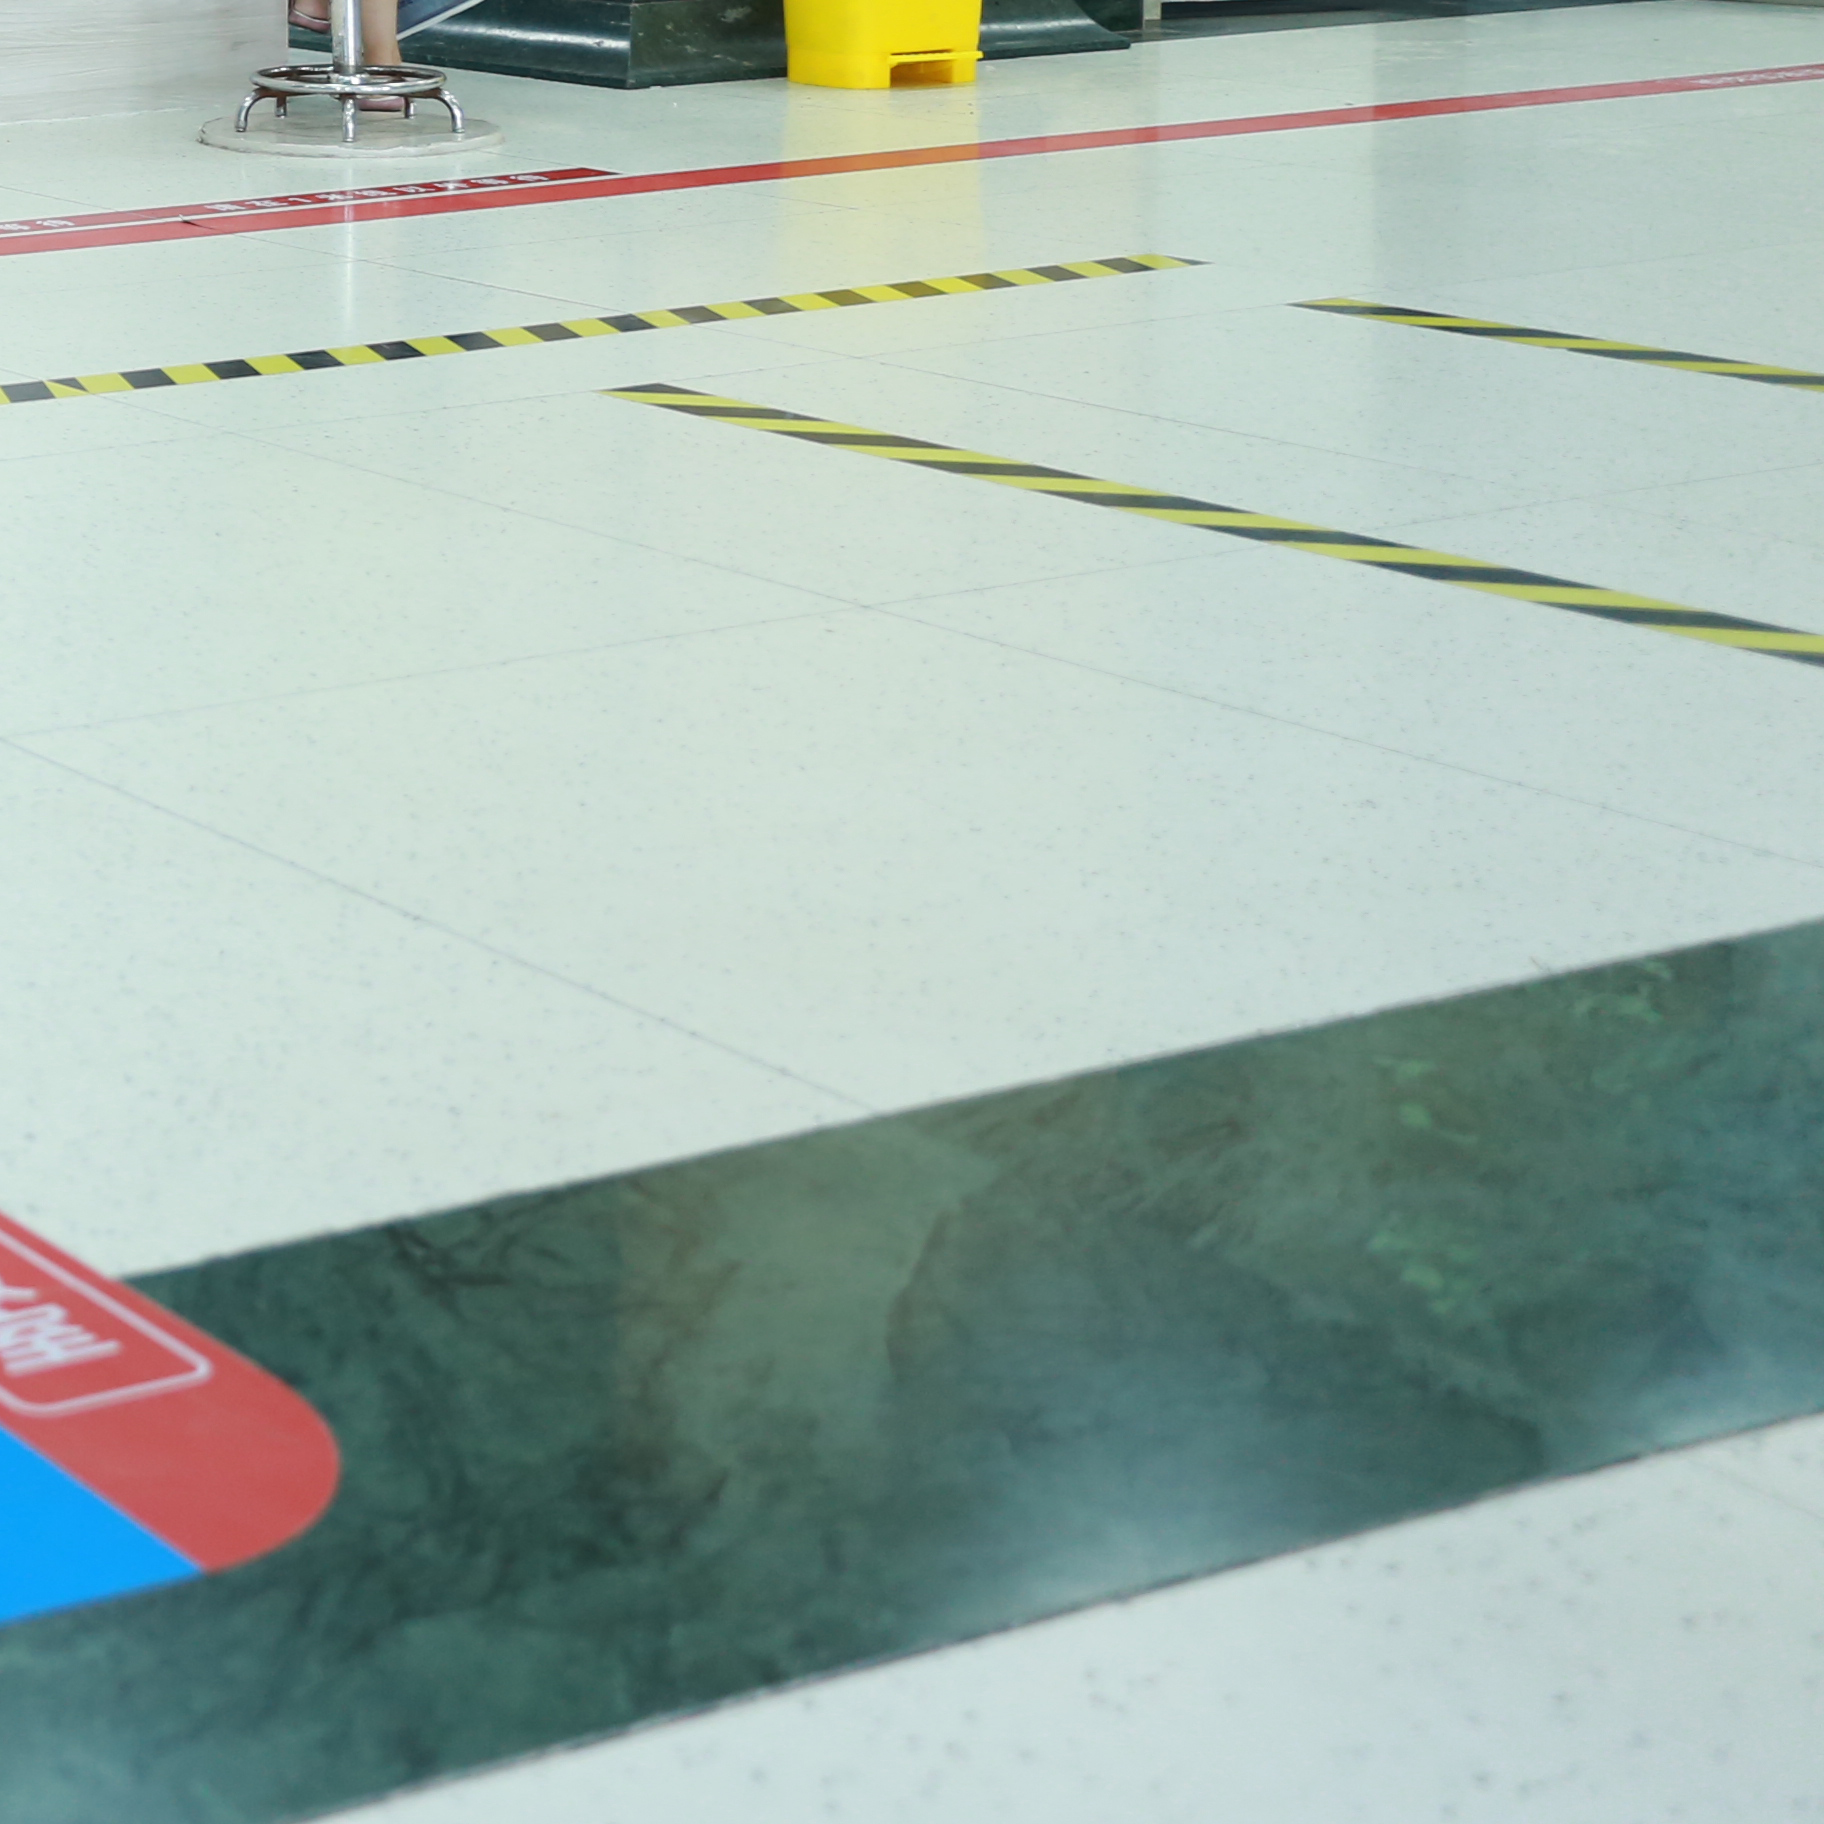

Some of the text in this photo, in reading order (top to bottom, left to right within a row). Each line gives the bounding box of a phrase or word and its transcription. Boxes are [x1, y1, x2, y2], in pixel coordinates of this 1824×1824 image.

[204, 174, 550, 211] 请在1米线以外等待
